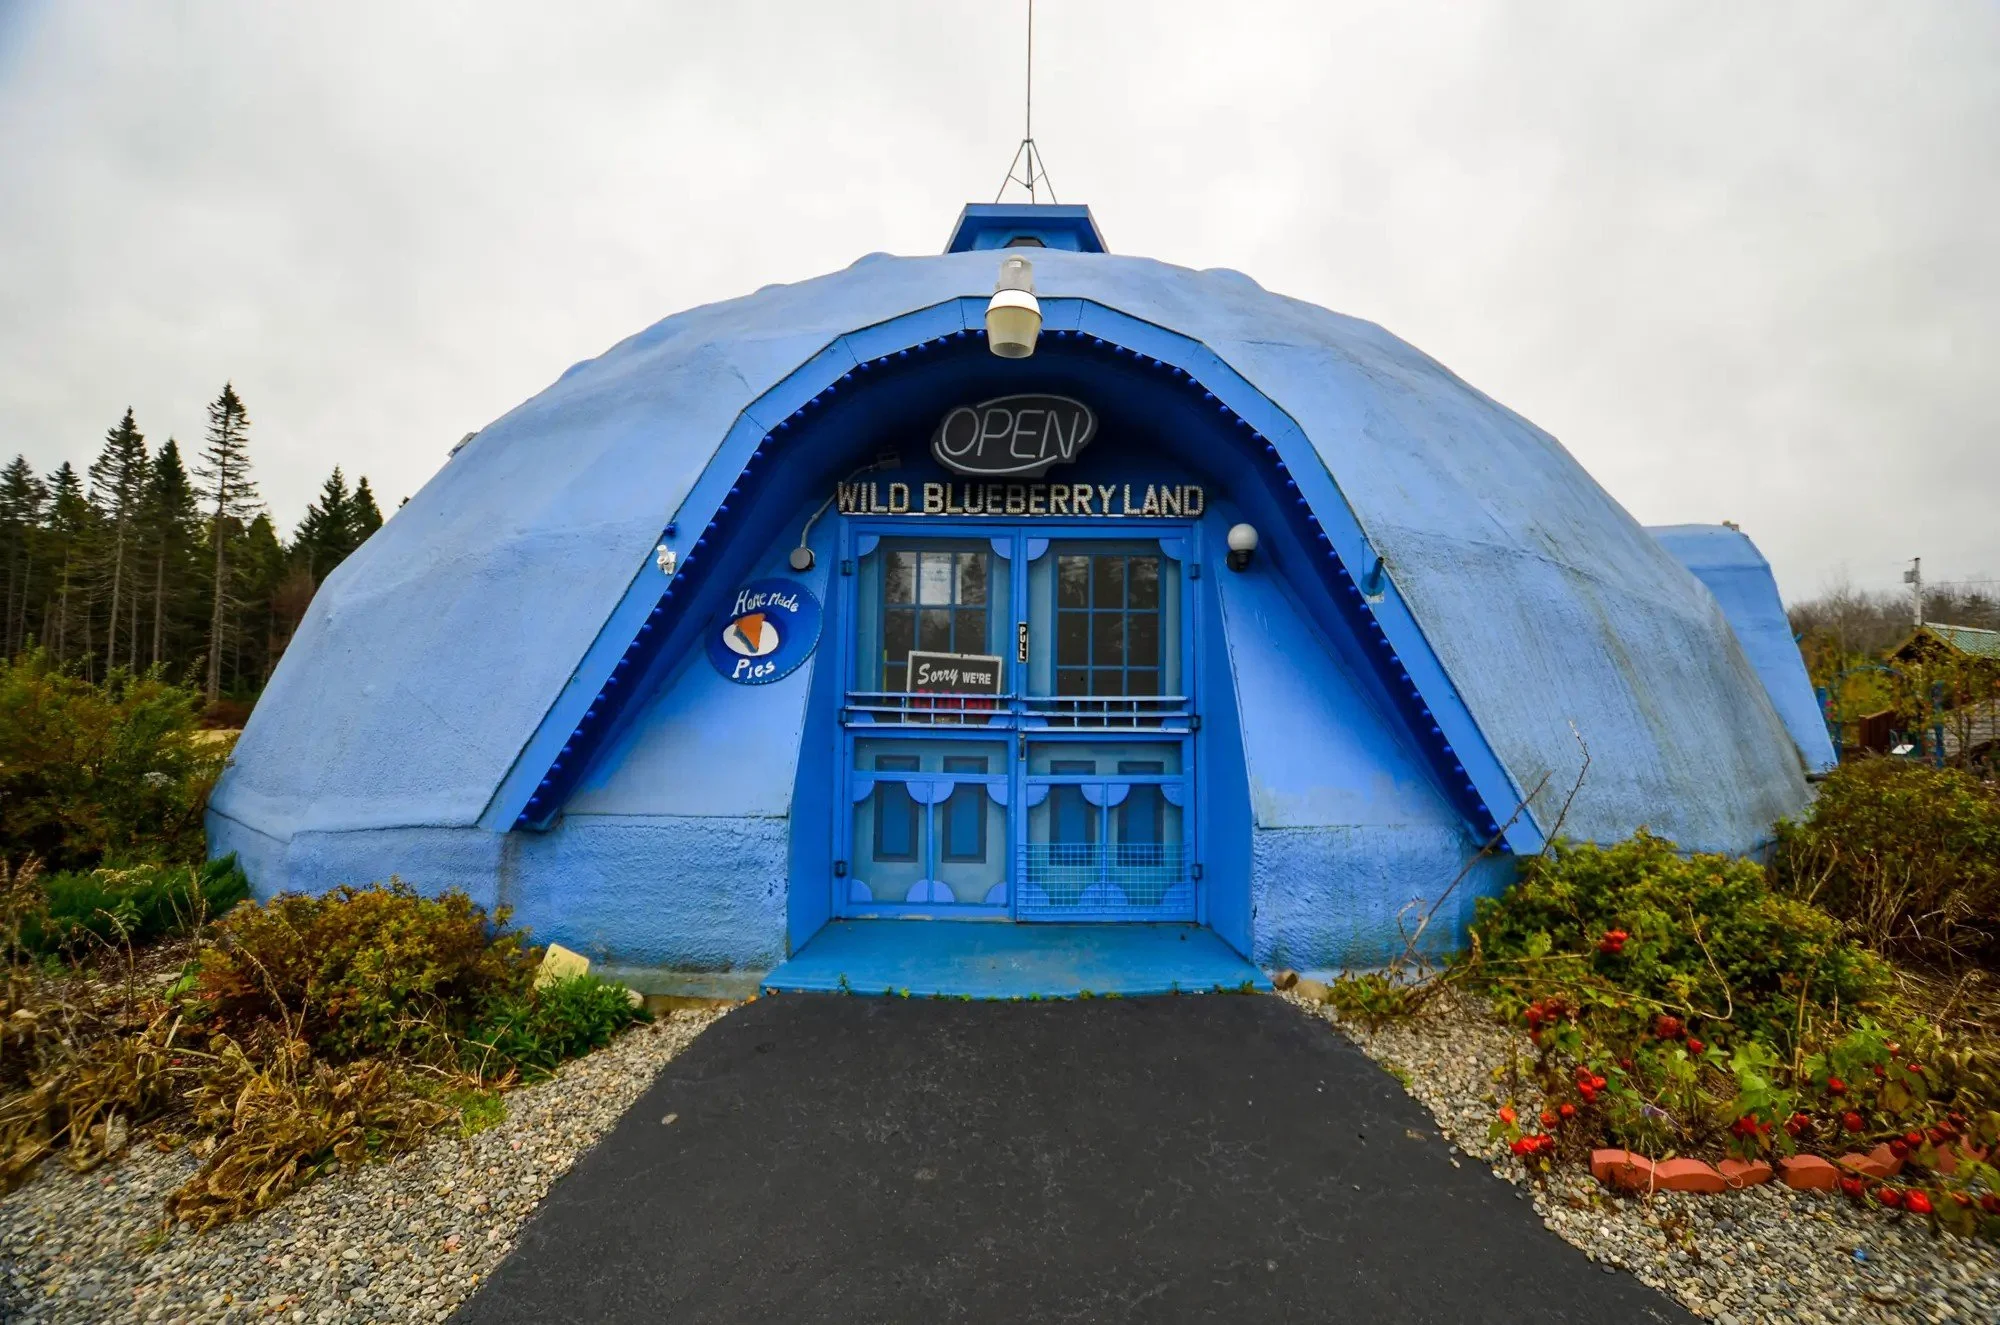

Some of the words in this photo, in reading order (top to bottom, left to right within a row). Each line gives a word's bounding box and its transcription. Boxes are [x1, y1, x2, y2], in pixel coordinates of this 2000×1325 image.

[942, 407, 1080, 458] OPEN
[838, 481, 910, 513] WILD
[923, 482, 1116, 514] BLUEBERRY
[1123, 484, 1204, 515] LAND
[1019, 626, 1027, 659] PULL
[732, 658, 776, 679] Pies
[917, 663, 959, 686] Sorry
[962, 671, 992, 685] WE'RE
